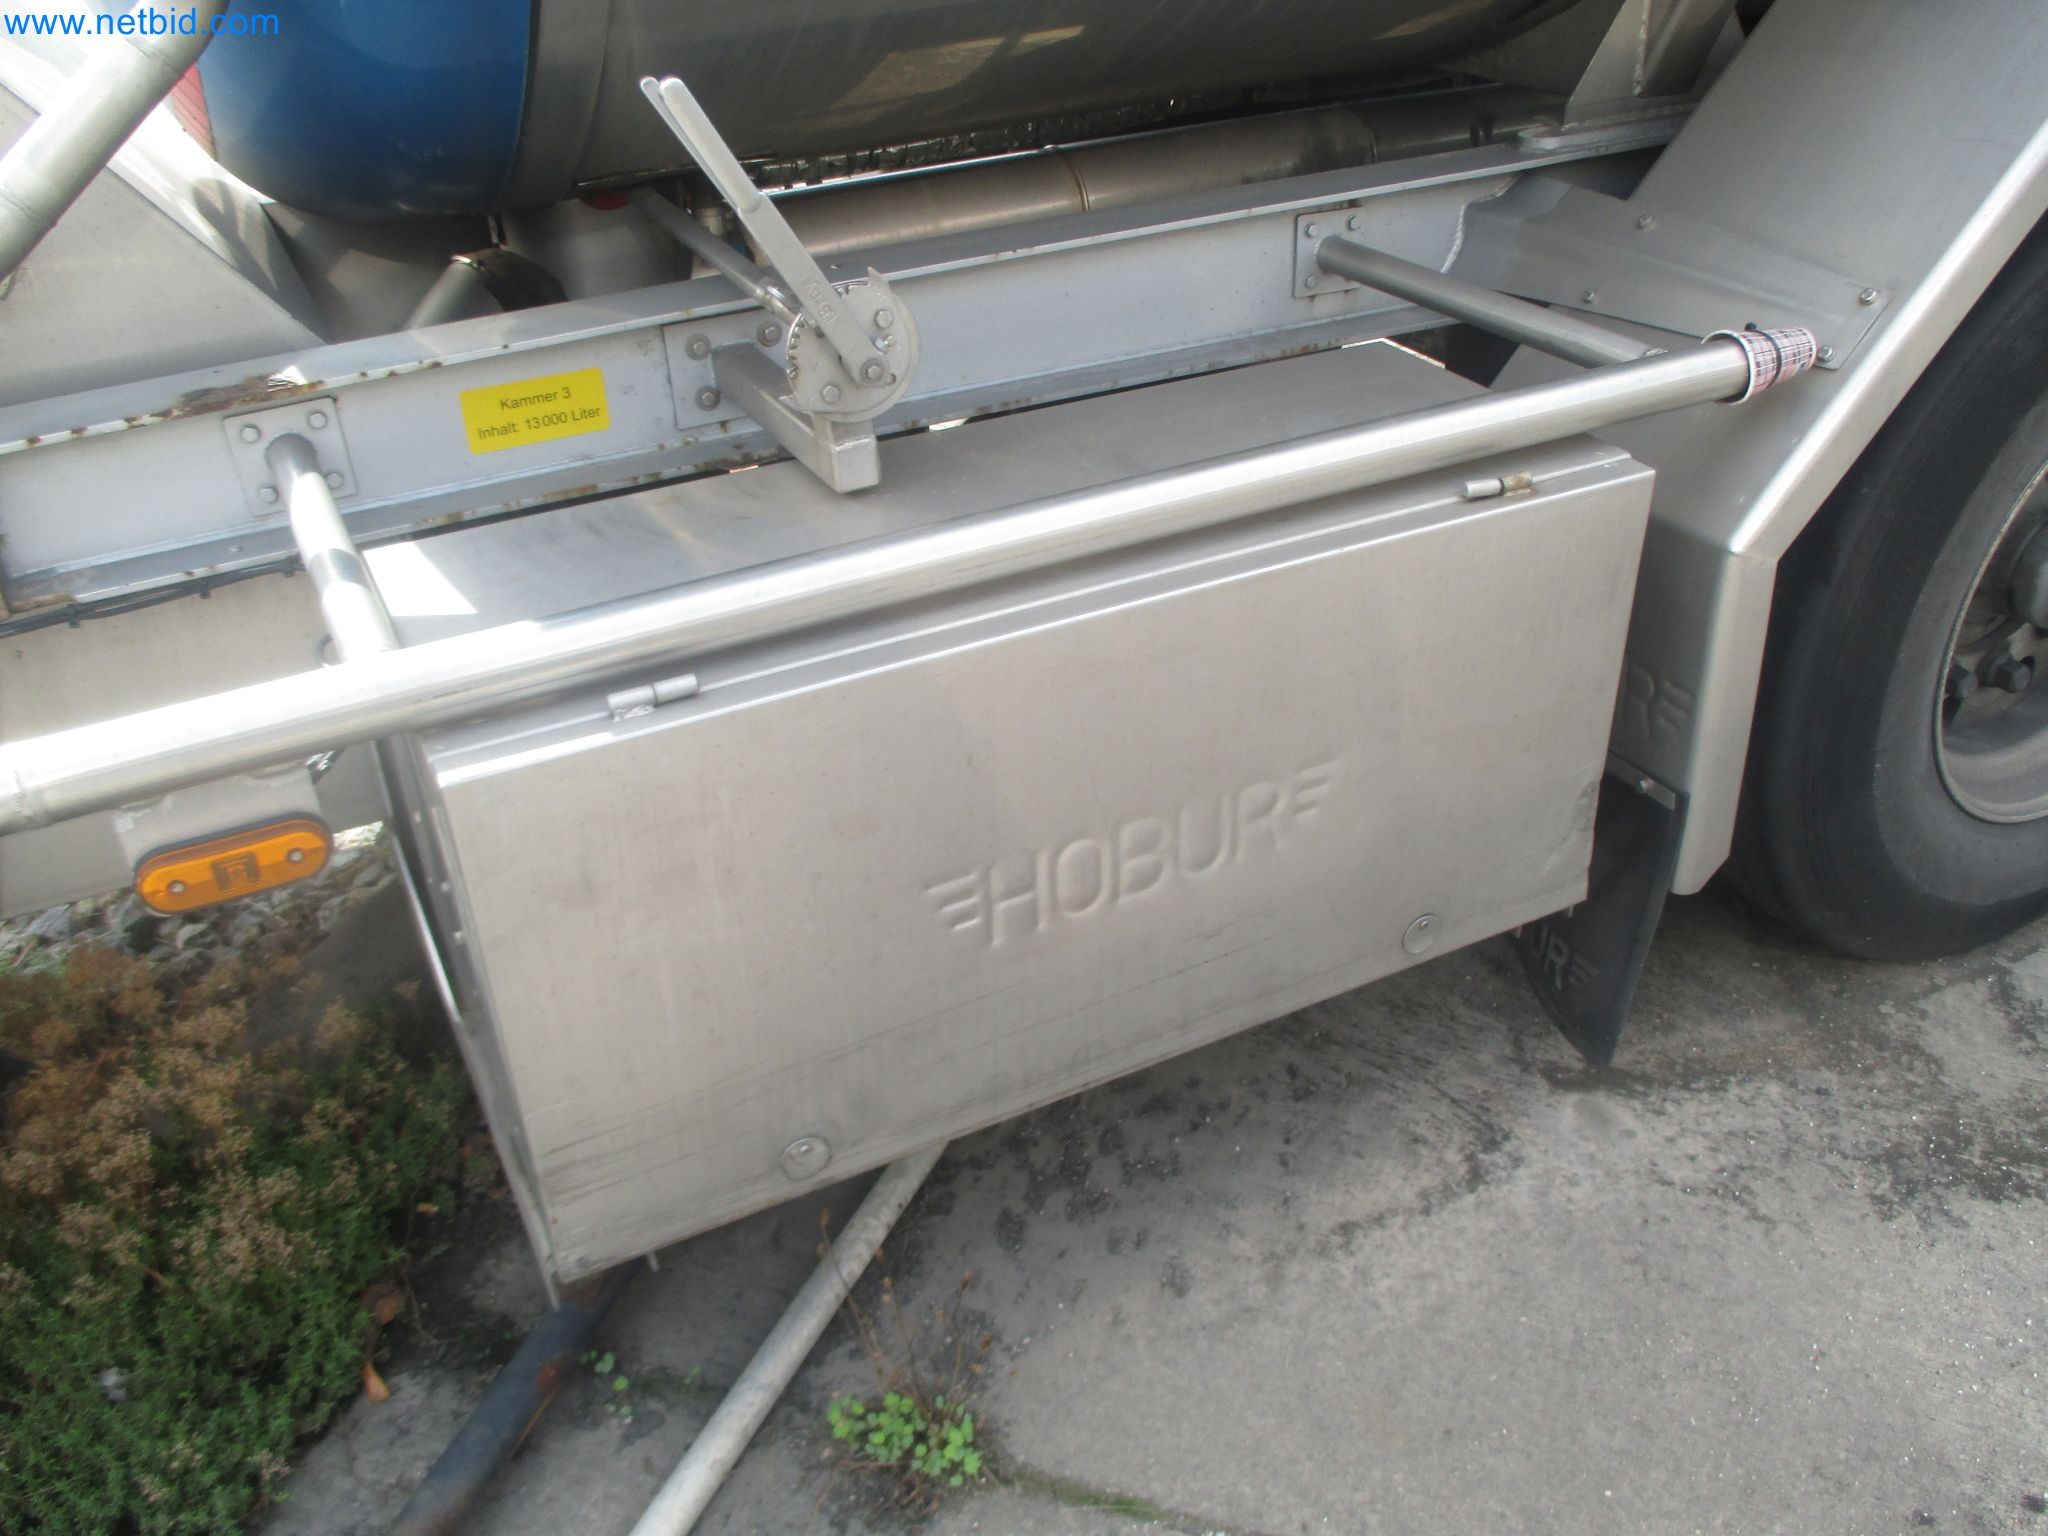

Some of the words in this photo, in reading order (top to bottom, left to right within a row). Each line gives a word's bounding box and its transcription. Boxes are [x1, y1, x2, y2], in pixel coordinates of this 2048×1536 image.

[500, 390, 559, 411] Kammer
[561, 386, 572, 400] 3
[477, 421, 520, 440] Inhalt:
[571, 406, 601, 422] Liter
